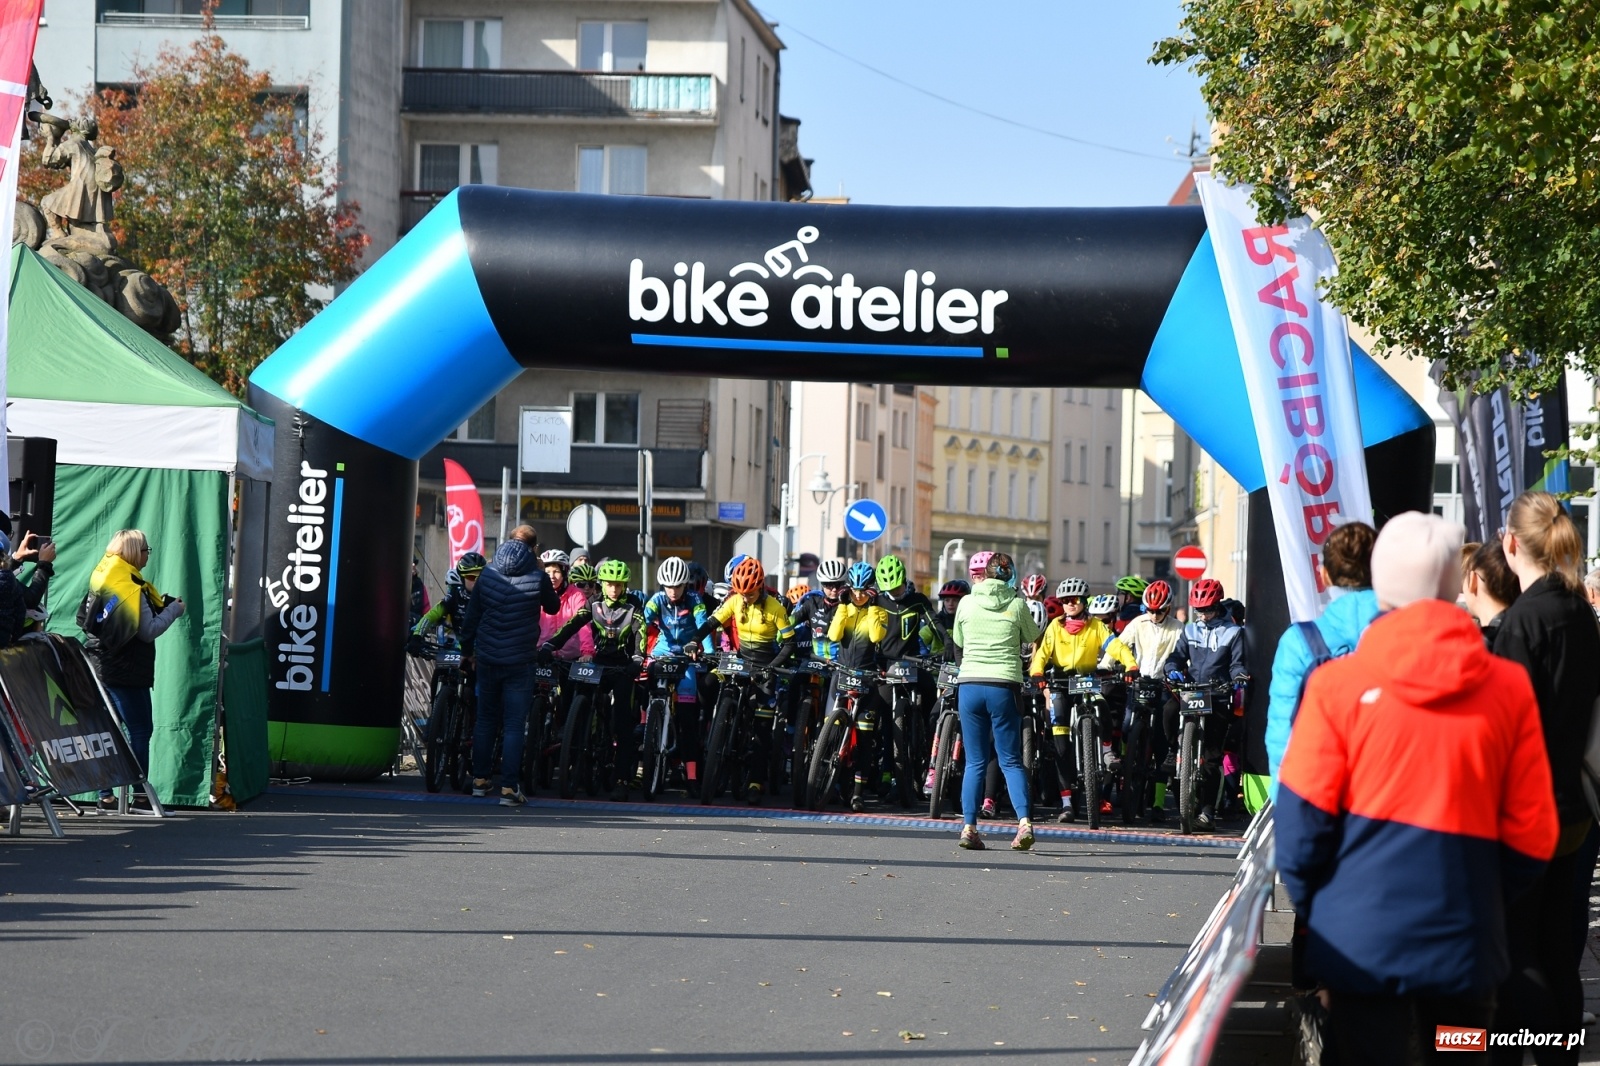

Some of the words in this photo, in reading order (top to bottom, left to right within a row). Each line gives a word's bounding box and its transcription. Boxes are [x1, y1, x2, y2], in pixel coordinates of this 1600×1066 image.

[628, 257, 770, 328] bike
[790, 269, 1009, 335] atelier
[529, 432, 556, 446] MINI
[605, 504, 640, 515] DROGERI
[286, 459, 328, 592] atelier
[275, 603, 318, 692] bike
[443, 653, 461, 662] 252
[662, 664, 678, 673] 187
[726, 662, 744, 671] 120
[577, 667, 594, 676] 109
[894, 668, 910, 676] 101
[845, 677, 862, 687] 132
[1139, 690, 1156, 698] 226
[1187, 700, 1205, 709] 270
[41, 731, 118, 766] MERIDA
